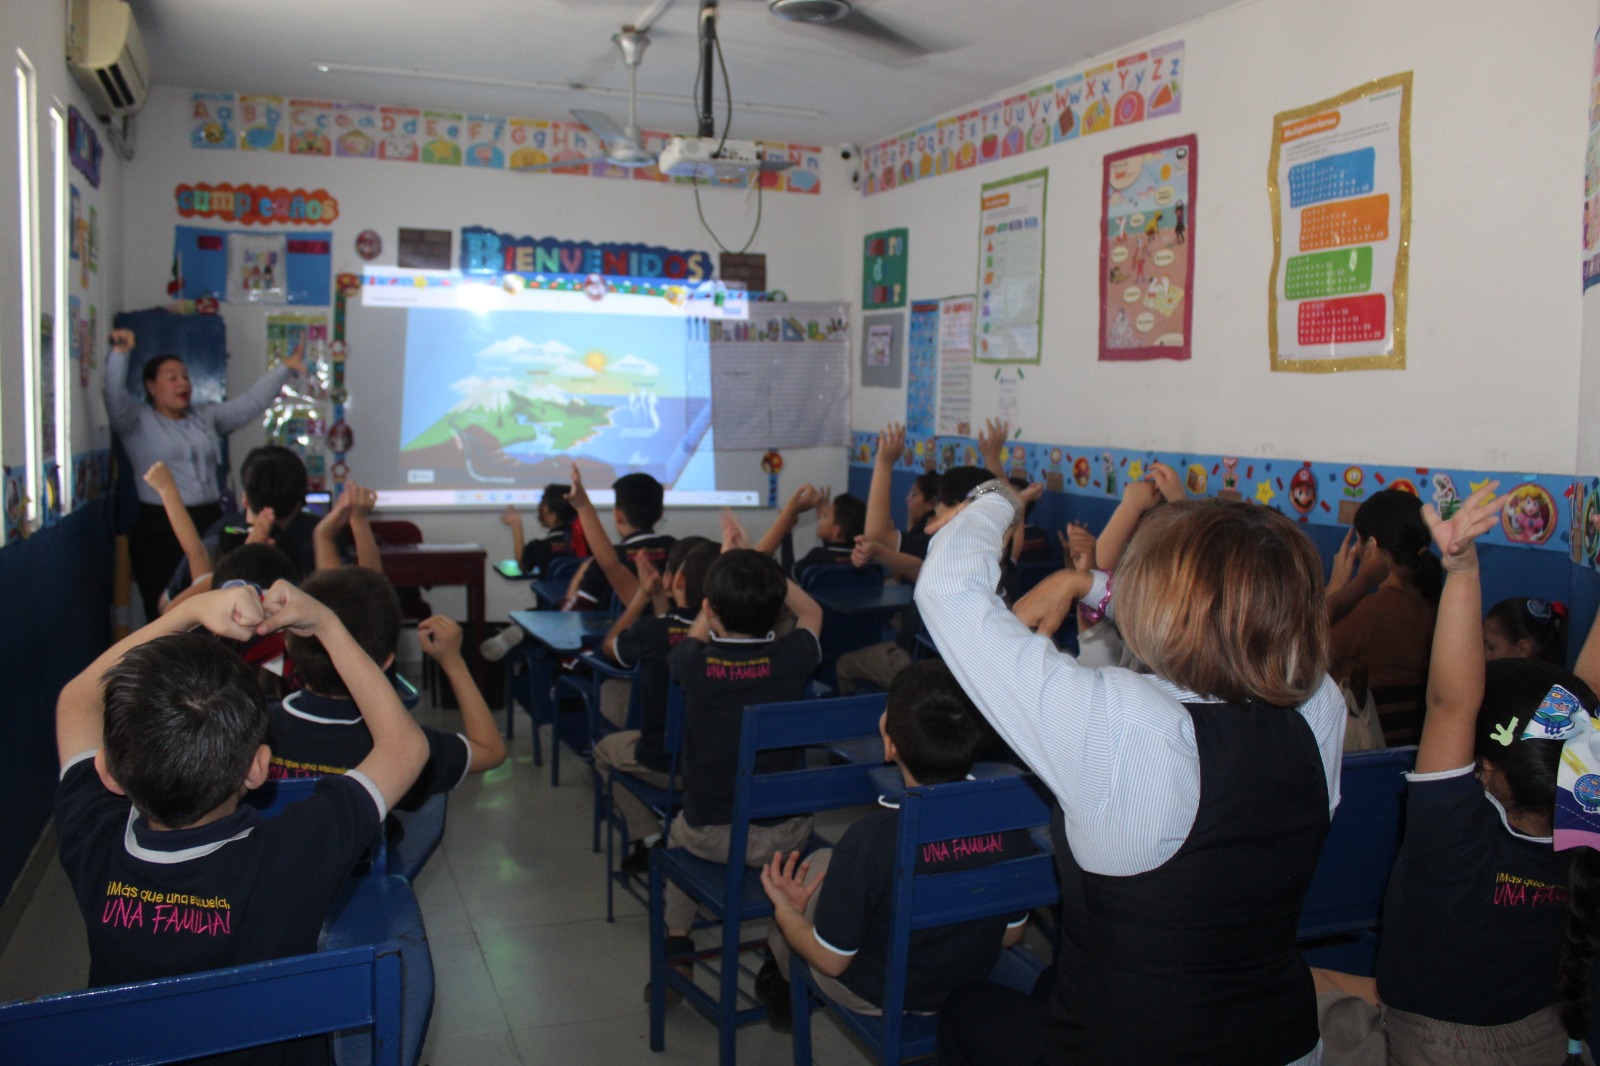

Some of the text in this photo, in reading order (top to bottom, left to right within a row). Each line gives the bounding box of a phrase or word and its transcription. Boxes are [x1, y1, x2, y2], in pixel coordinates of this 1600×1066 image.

[1118, 69, 1145, 90] Y y
[1152, 58, 1180, 81] Z z
[1055, 88, 1081, 109] W w
[1085, 78, 1110, 100] X x
[193, 101, 233, 121] A a
[243, 104, 281, 122] B b
[291, 109, 328, 128] C c
[1004, 107, 1024, 126] U u
[1028, 99, 1051, 119] V v
[381, 116, 417, 134] D d
[425, 120, 459, 138] E e
[468, 123, 482, 138] F
[959, 123, 976, 141] S s
[982, 112, 998, 132] T t
[511, 128, 547, 148] G g
[553, 131, 587, 148] H h
[938, 129, 945, 146] R
[465, 232, 703, 282] BIENVENIDOS
[923, 834, 1004, 863] UNA FAMILIA!
[140, 889, 164, 903] que
[166, 892, 189, 905] una
[1494, 883, 1527, 908] UNA
[102, 897, 231, 936] UNA FAMILIA!
